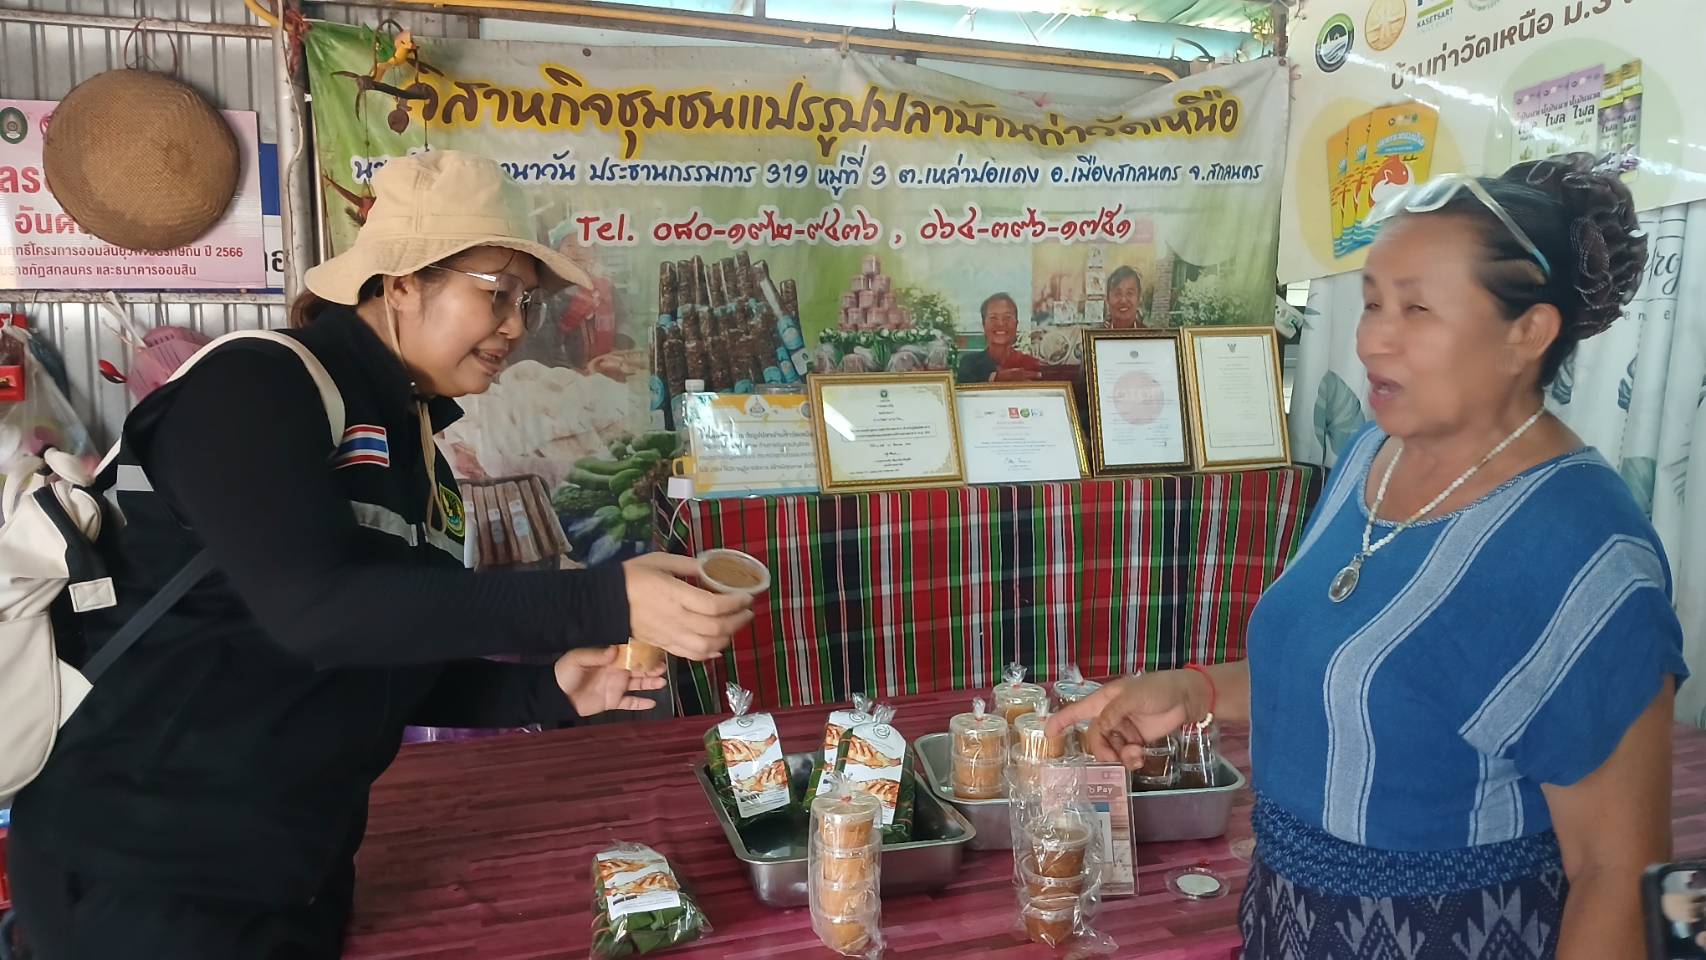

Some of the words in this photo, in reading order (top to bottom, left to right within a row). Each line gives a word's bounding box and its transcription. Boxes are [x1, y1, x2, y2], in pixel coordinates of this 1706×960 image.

[1416, 7, 1454, 28] KASETSART
[1391, 8, 1554, 90] บ้านท่าวัดเหนือ
[589, 157, 757, 183] ประธานกรรมการ
[766, 163, 808, 184] 319
[818, 145, 867, 196] หมู่ที่
[871, 165, 887, 185] 3
[899, 153, 1039, 185] ต.เหล่าปอแดง
[1050, 155, 1183, 183] อ.เมืองสกลนคร
[1188, 162, 1264, 181] จ.สกลนคร
[576, 213, 634, 241] Tel.
[205, 245, 212, 257] ปี
[216, 247, 243, 257] 2566
[96, 265, 196, 276] และธนาคารออมสิน
[1096, 785, 1113, 796] Pay
